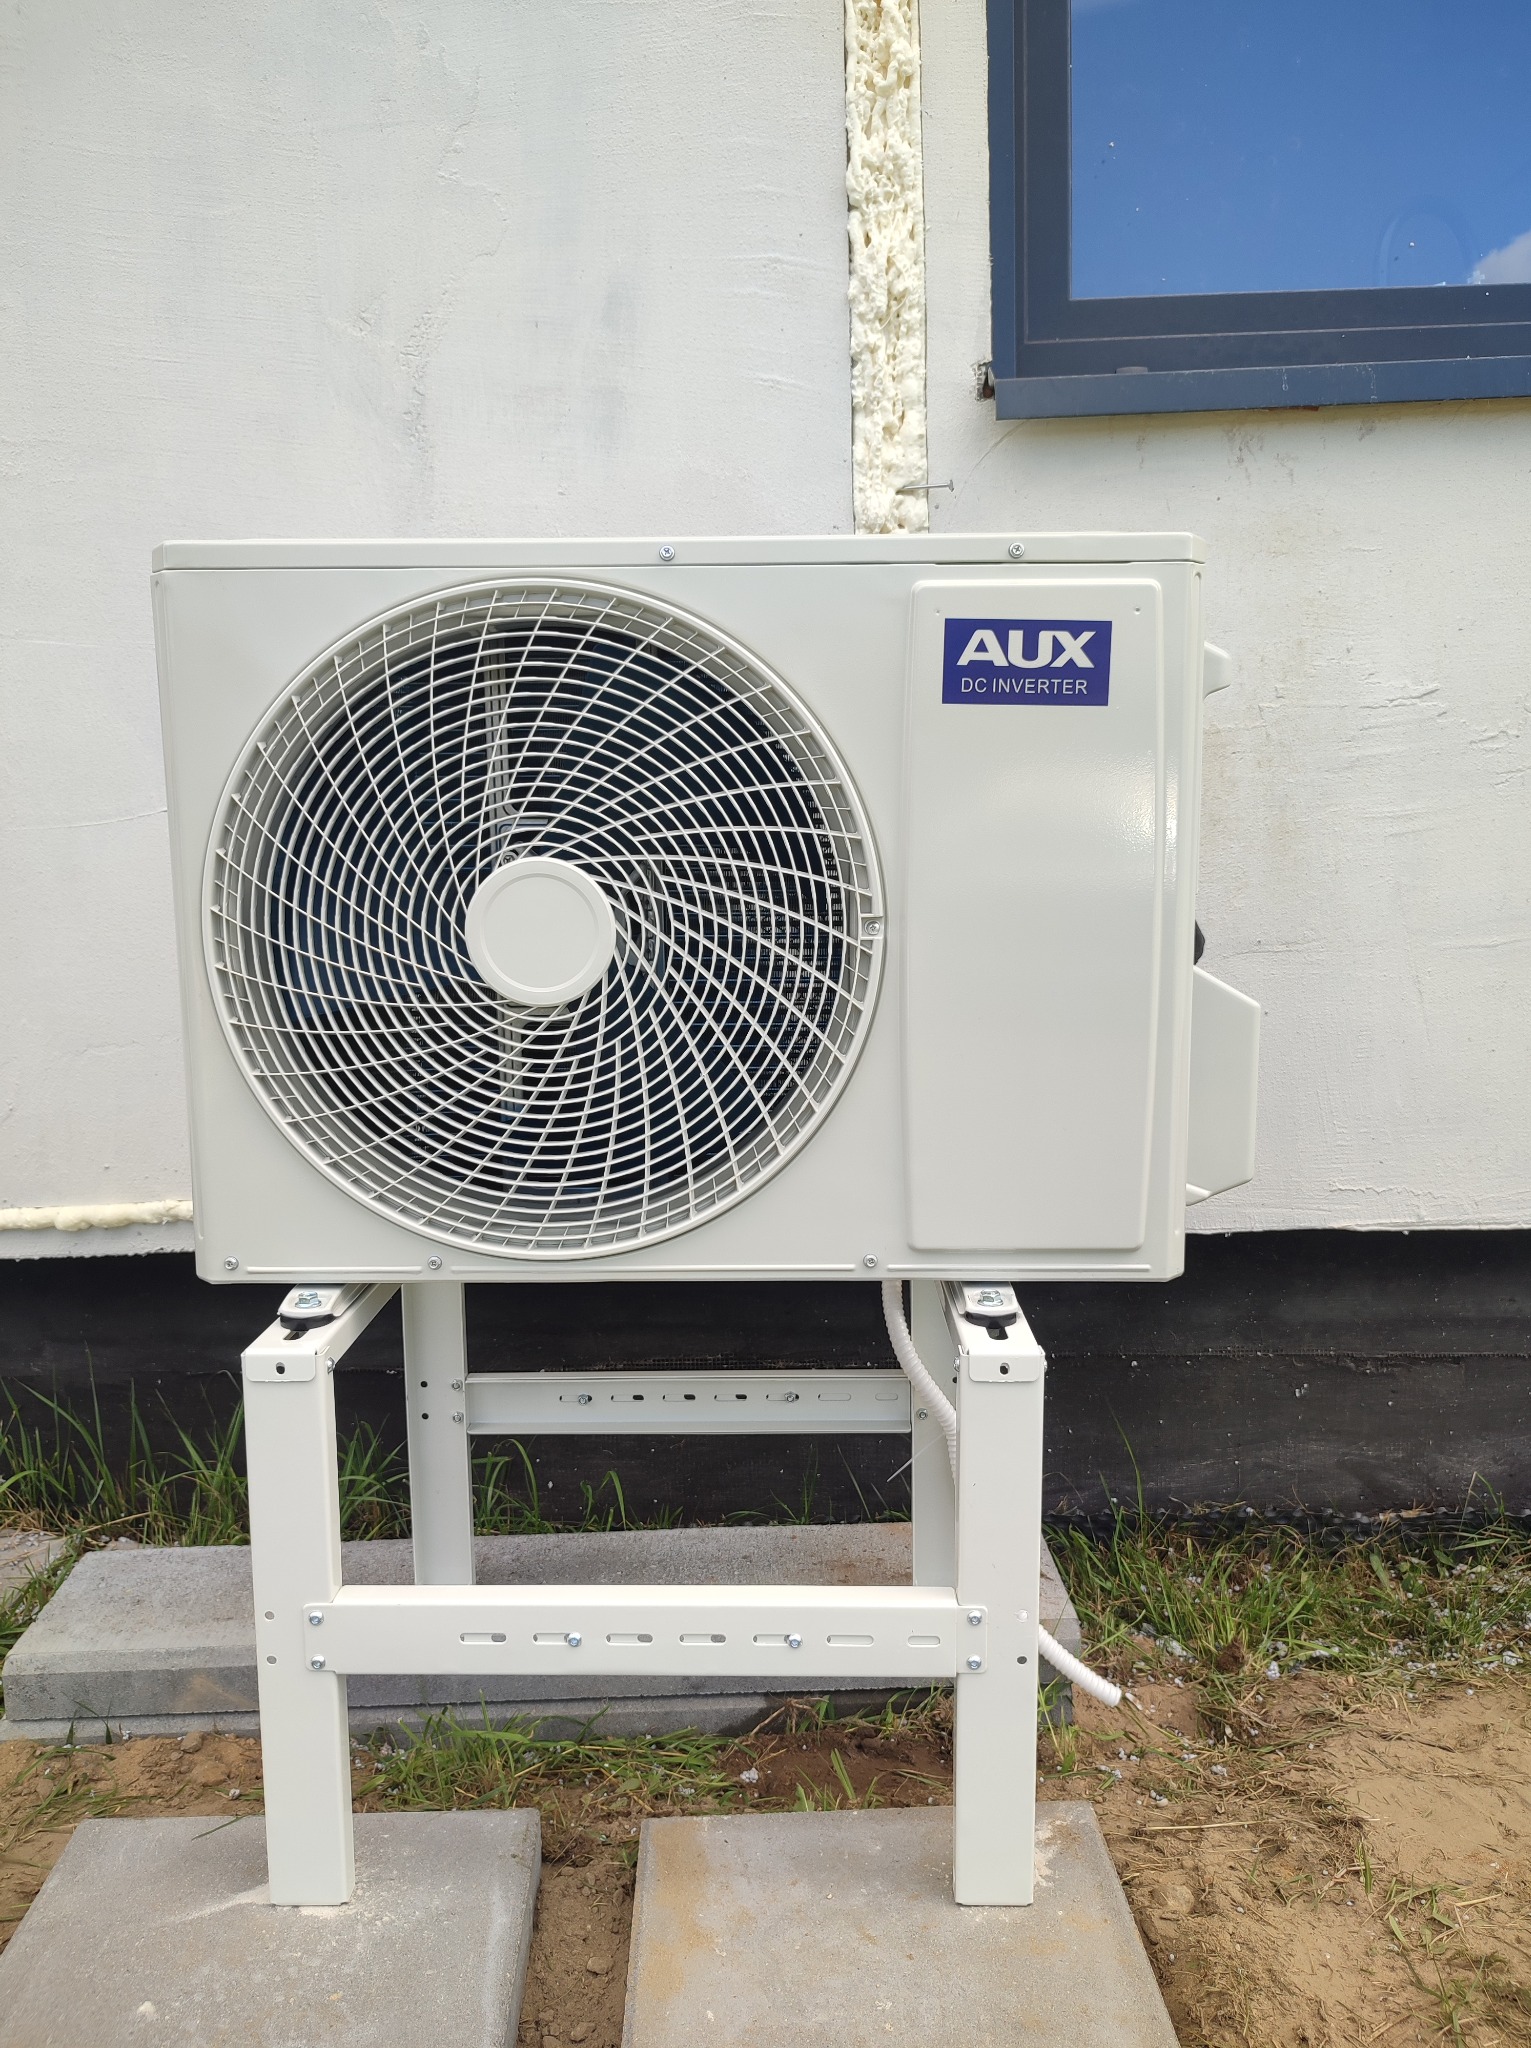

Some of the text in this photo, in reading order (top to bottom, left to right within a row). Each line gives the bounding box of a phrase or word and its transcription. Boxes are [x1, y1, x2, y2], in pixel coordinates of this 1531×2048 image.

[956, 629, 1096, 668] AUX
[961, 677, 1088, 695] DC INVERTER
